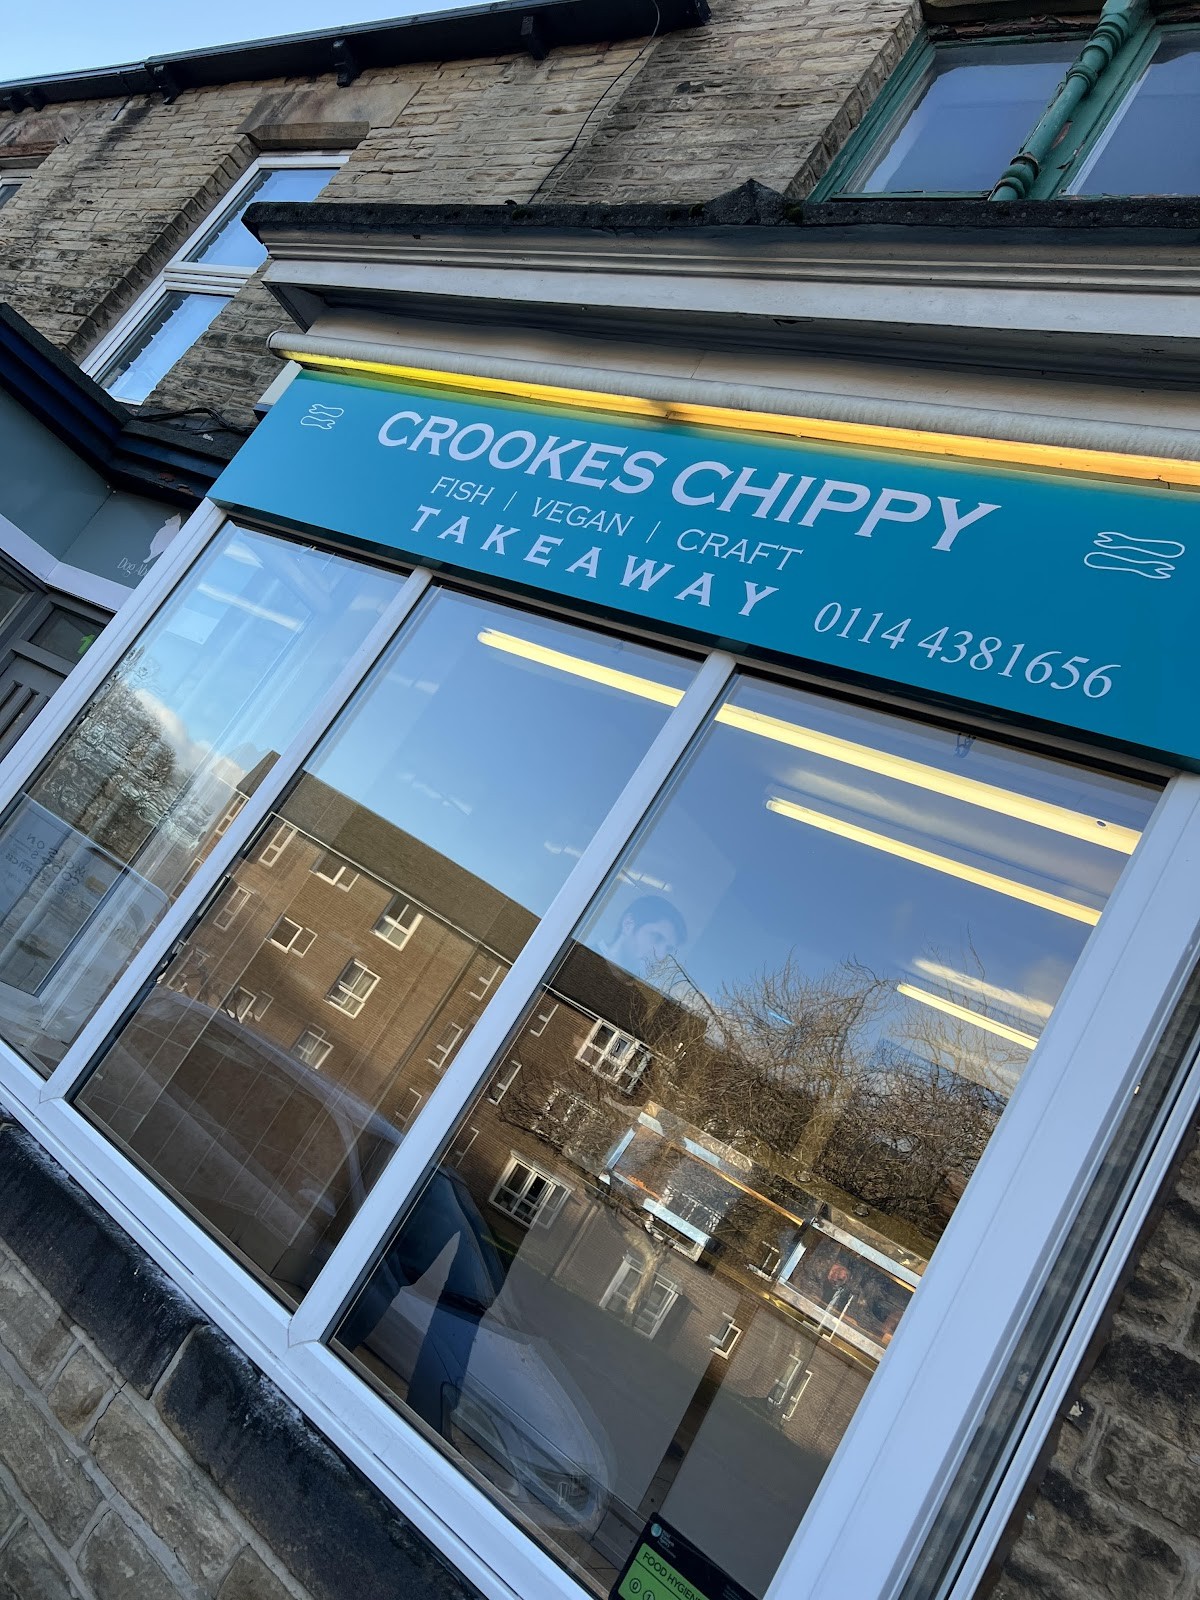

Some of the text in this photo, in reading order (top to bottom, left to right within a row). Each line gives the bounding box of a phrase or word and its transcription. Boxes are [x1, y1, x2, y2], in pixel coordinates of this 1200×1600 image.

[378, 411, 1002, 552] CROOKES CHIPPY
[431, 476, 495, 506] FISH
[532, 497, 634, 536] VEGAN
[677, 529, 803, 571] CRAFT
[411, 505, 779, 617] TAKEAWAY
[813, 602, 1121, 699] 0114 4381656
[643, 1552, 667, 1577] FOOD
[667, 1574, 700, 1600] HYGIEN
